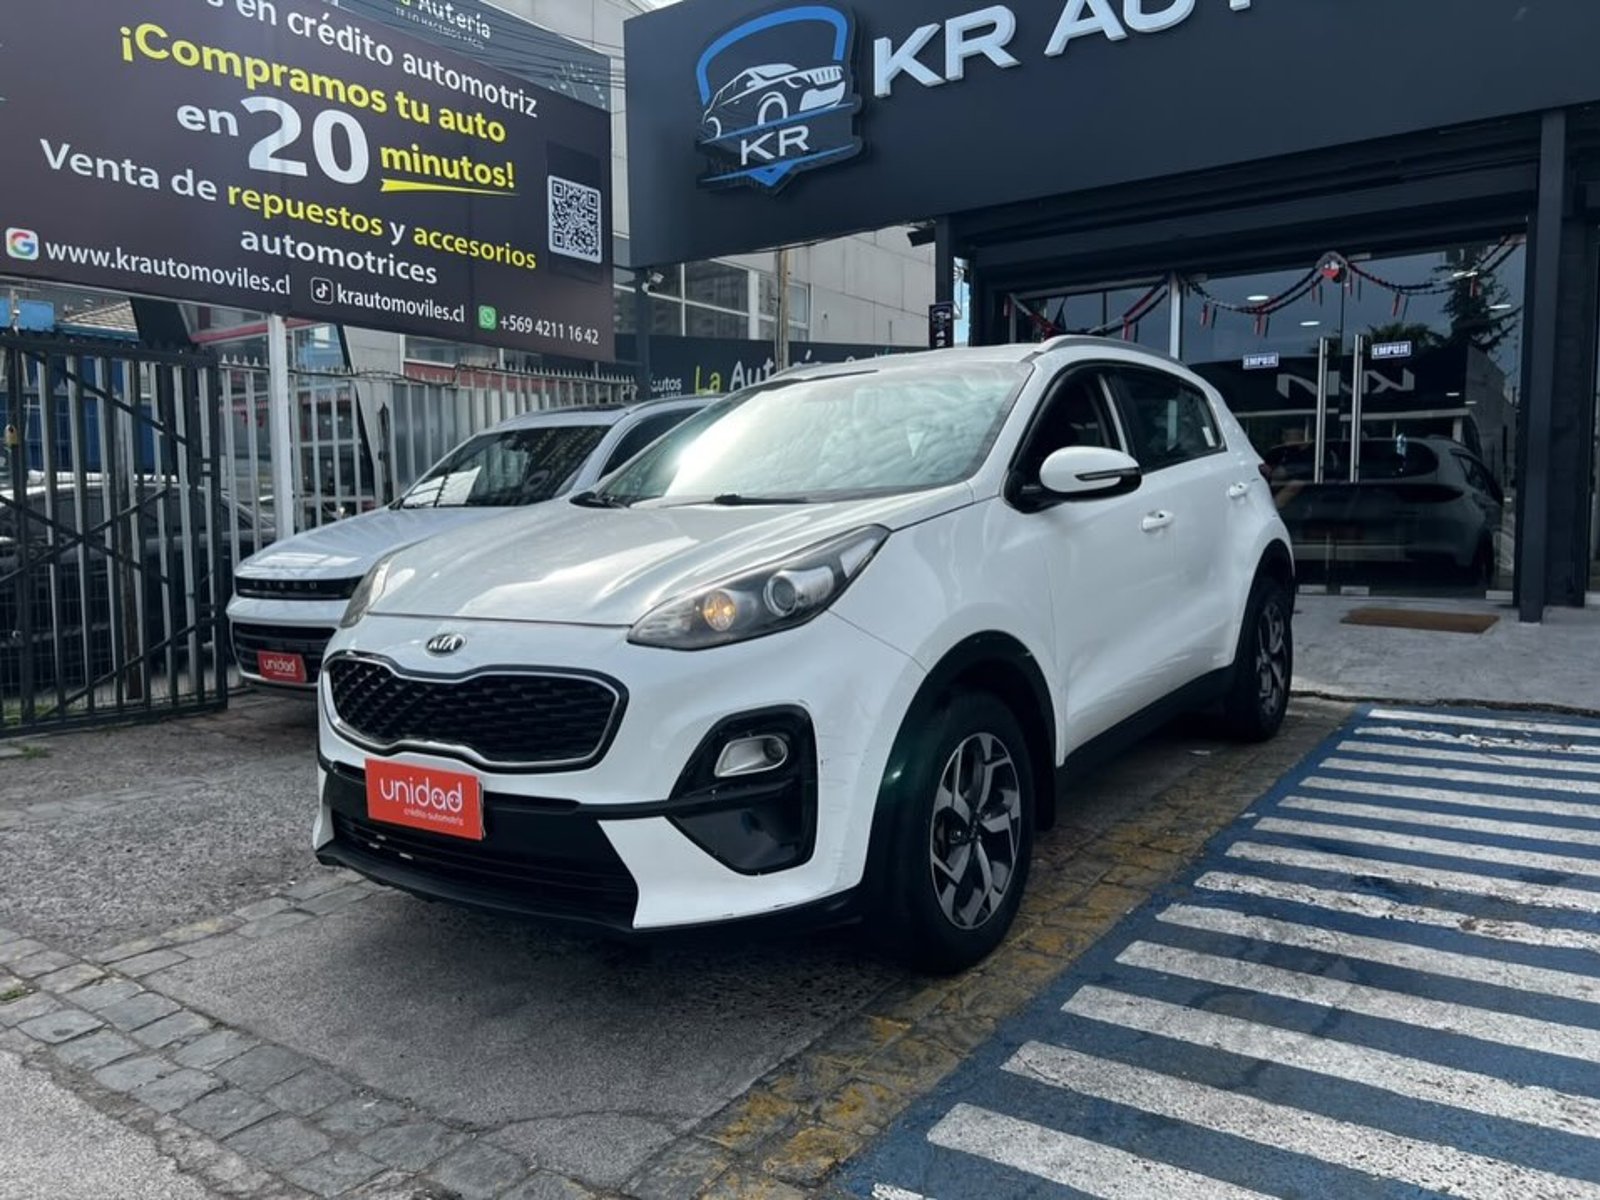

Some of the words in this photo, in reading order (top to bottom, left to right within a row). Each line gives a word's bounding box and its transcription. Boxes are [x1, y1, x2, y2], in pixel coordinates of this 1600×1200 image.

[236, 0, 277, 26] en
[287, 12, 394, 66] crédito
[403, 53, 538, 118] automotriz
[873, 4, 1022, 99] KR
[120, 23, 388, 113] ¡Compramos
[395, 91, 430, 124] tu
[438, 108, 506, 142] auto
[177, 105, 239, 137] en
[240, 96, 369, 184] 20
[380, 143, 515, 189] minutos!
[740, 125, 810, 166] KR
[40, 138, 160, 189] Venta
[171, 168, 217, 201] de
[228, 185, 383, 236] repuestos
[389, 221, 406, 246] y
[413, 227, 537, 269] accesorios
[45, 241, 291, 295] www.krautomoviles.cl
[240, 230, 438, 284] automotrices
[337, 283, 465, 323] krautomoviles.cl
[500, 315, 533, 334] +569
[535, 318, 564, 339] 4211
[568, 325, 582, 343] 16
[583, 328, 599, 345] 42
[695, 366, 721, 396] La
[380, 776, 463, 813] unidad
